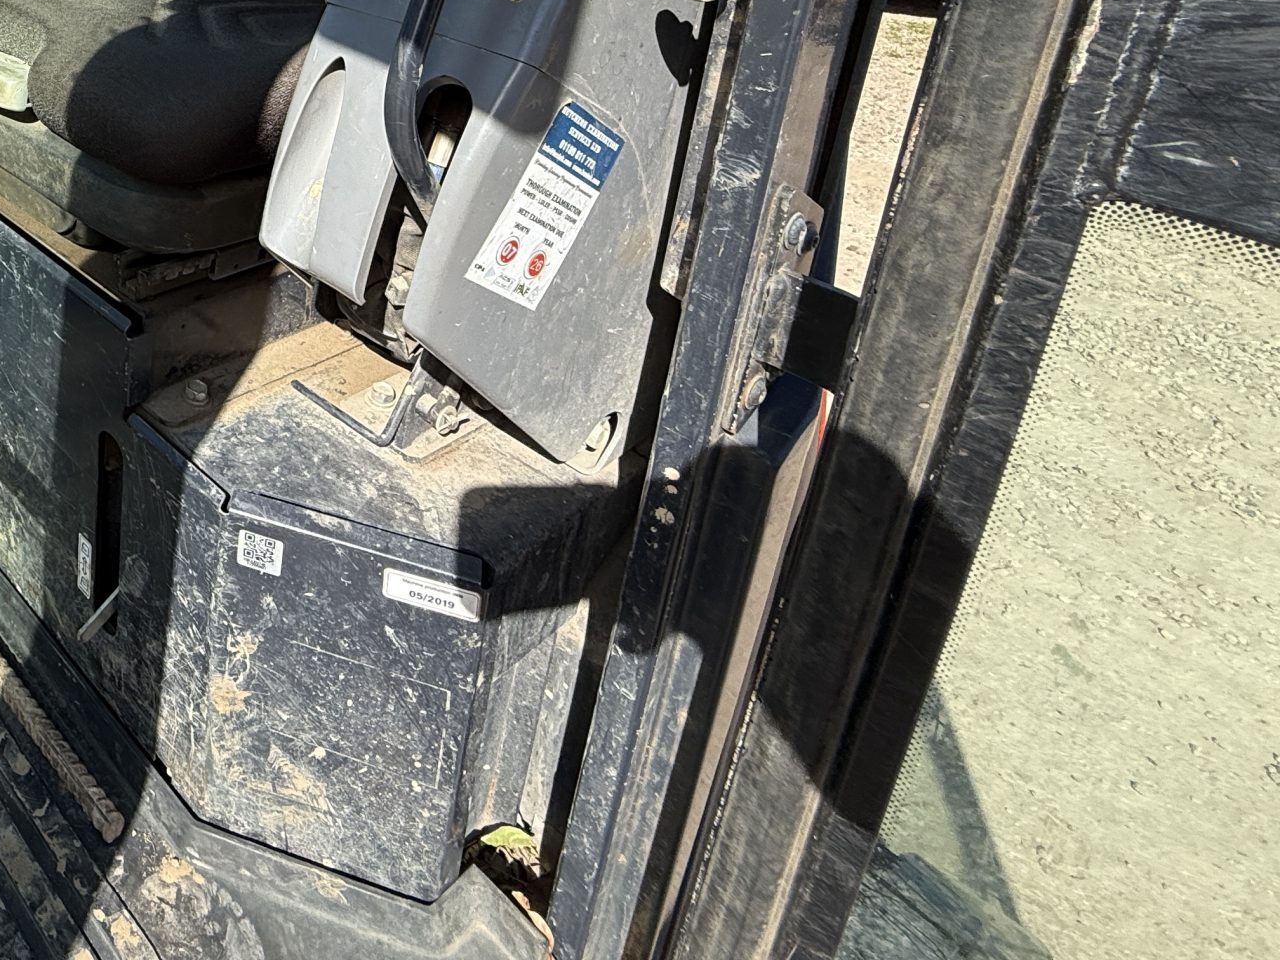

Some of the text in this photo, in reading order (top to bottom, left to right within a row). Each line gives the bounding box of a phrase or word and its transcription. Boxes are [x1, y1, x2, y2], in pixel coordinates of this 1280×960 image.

[526, 178, 552, 199] THOROUGH
[551, 192, 582, 217] EXAMINATION
[517, 207, 565, 238] NEXT EXAMINATION DUE
[501, 242, 518, 260] 07
[543, 238, 554, 248] YEAR
[529, 259, 544, 272] 26
[408, 590, 455, 609] 05/2019
